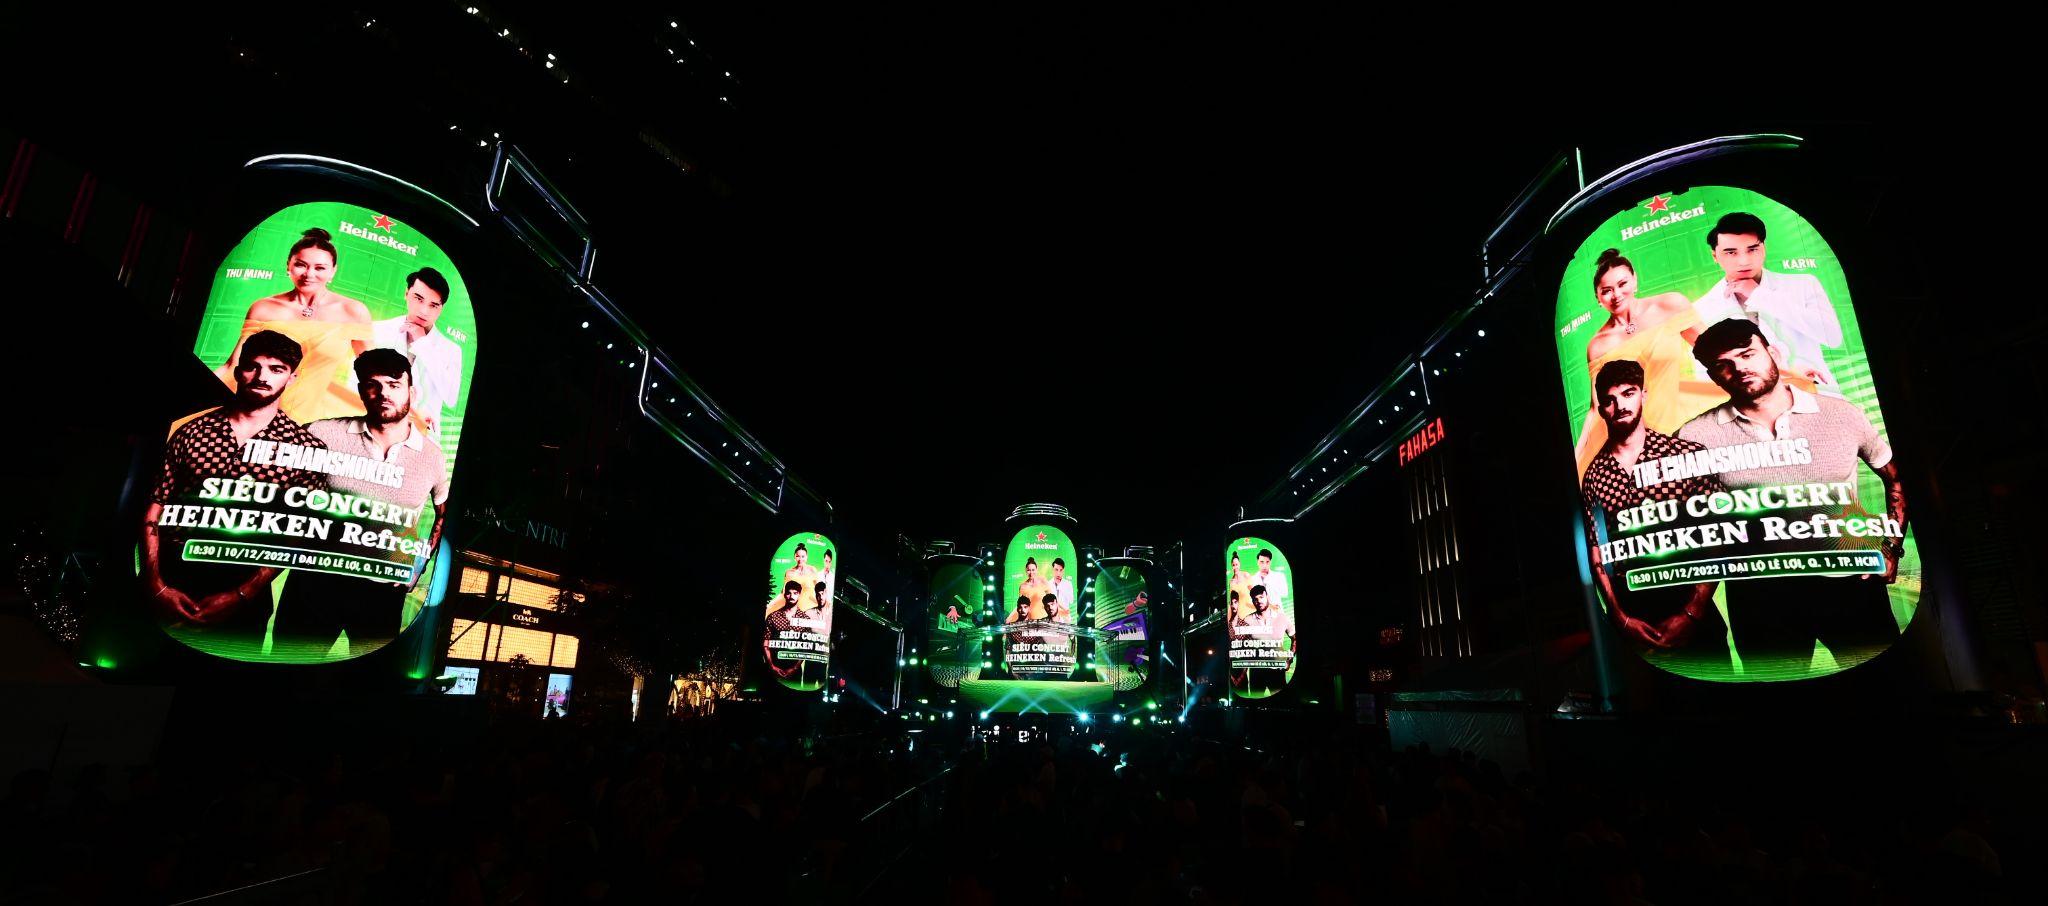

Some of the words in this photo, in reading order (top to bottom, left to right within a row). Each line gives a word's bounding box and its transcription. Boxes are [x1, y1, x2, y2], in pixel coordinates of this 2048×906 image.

[339, 221, 419, 256] Heineken
[1621, 202, 1706, 241] Heineken
[226, 268, 243, 278] THU
[244, 268, 273, 280] MINH
[1783, 258, 1818, 270] KARIK
[1560, 323, 1573, 338] THU
[1572, 311, 1591, 331] MINH
[1399, 417, 1445, 466] FAHASA
[242, 439, 274, 464] THE
[273, 442, 405, 489] CHAINSMOKERS
[1632, 463, 1662, 489] THE
[1660, 438, 1813, 482] CHAINSMOKERS
[199, 474, 279, 505] SIÊU
[284, 487, 420, 529] CONCERT
[1616, 497, 1679, 532] SIÊU
[1686, 482, 1853, 519] CONCERT
[158, 504, 334, 541] HEINEKEN
[340, 521, 433, 560] Refresh
[1600, 519, 1750, 565] HEINEKEN
[1761, 512, 1904, 542] Refresh
[188, 545, 216, 555] 18:30
[224, 547, 291, 562] 10/12/2022
[298, 554, 318, 567] ĐẠI
[375, 564, 383, 576] 1,
[384, 566, 394, 577] TP.
[394, 569, 411, 579] HCM
[1629, 573, 1652, 586] 18:30
[1657, 564, 1720, 582] 10/12/2022
[1727, 562, 1749, 574] ĐẠI
[1807, 557, 1822, 568] Q.
[1823, 557, 1836, 569] 1,
[1836, 556, 1854, 567] TP.
[1853, 556, 1881, 567] HCM
[512, 614, 540, 624] COACH
[769, 640, 814, 650] HEINEKEN
[1006, 653, 1047, 662] HEINEKEN
[1012, 642, 1031, 652] SIÊU
[1031, 643, 1070, 653] CONCERT
